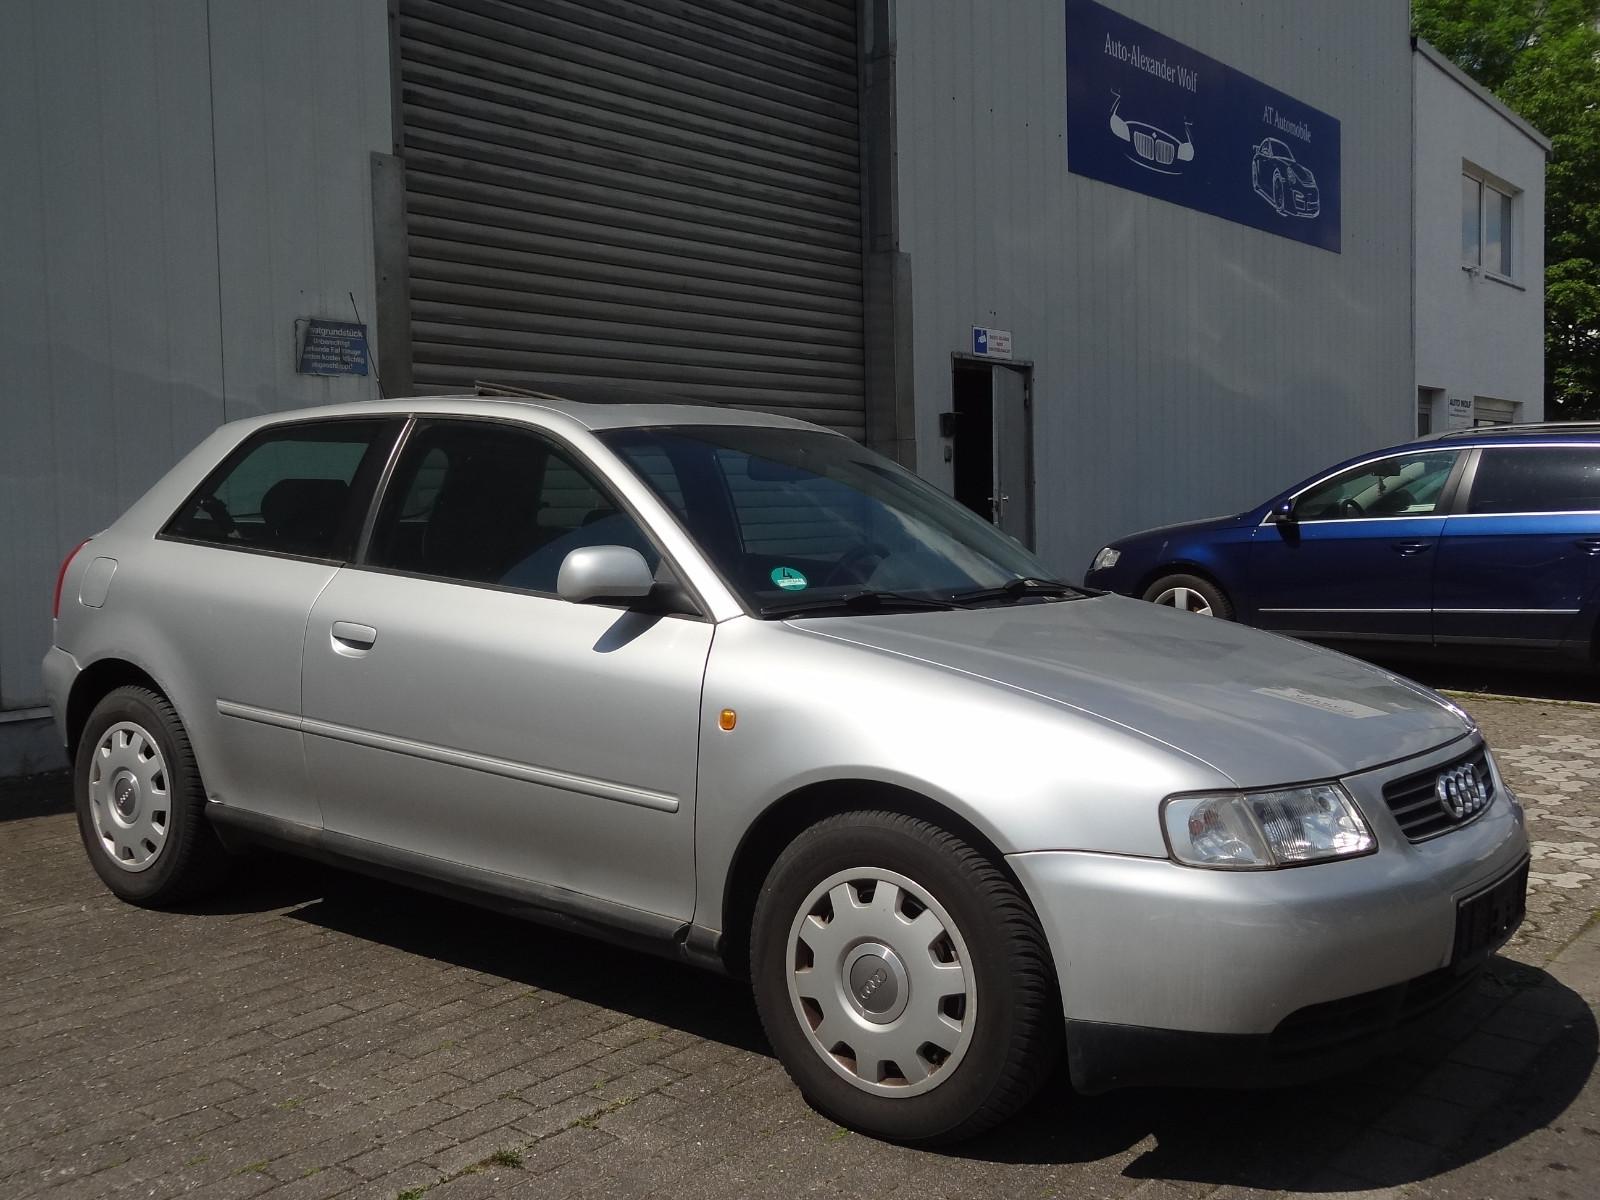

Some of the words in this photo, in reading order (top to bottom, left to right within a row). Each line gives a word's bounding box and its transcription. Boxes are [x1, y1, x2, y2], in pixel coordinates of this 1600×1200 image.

[1104, 32, 1176, 83] Auto-Alexander
[1177, 65, 1198, 94] Wolf
[1263, 105, 1274, 125] AT
[1274, 109, 1312, 144] Automobile
[1450, 399, 1460, 407] AUTO
[1461, 400, 1472, 408] WOLF
